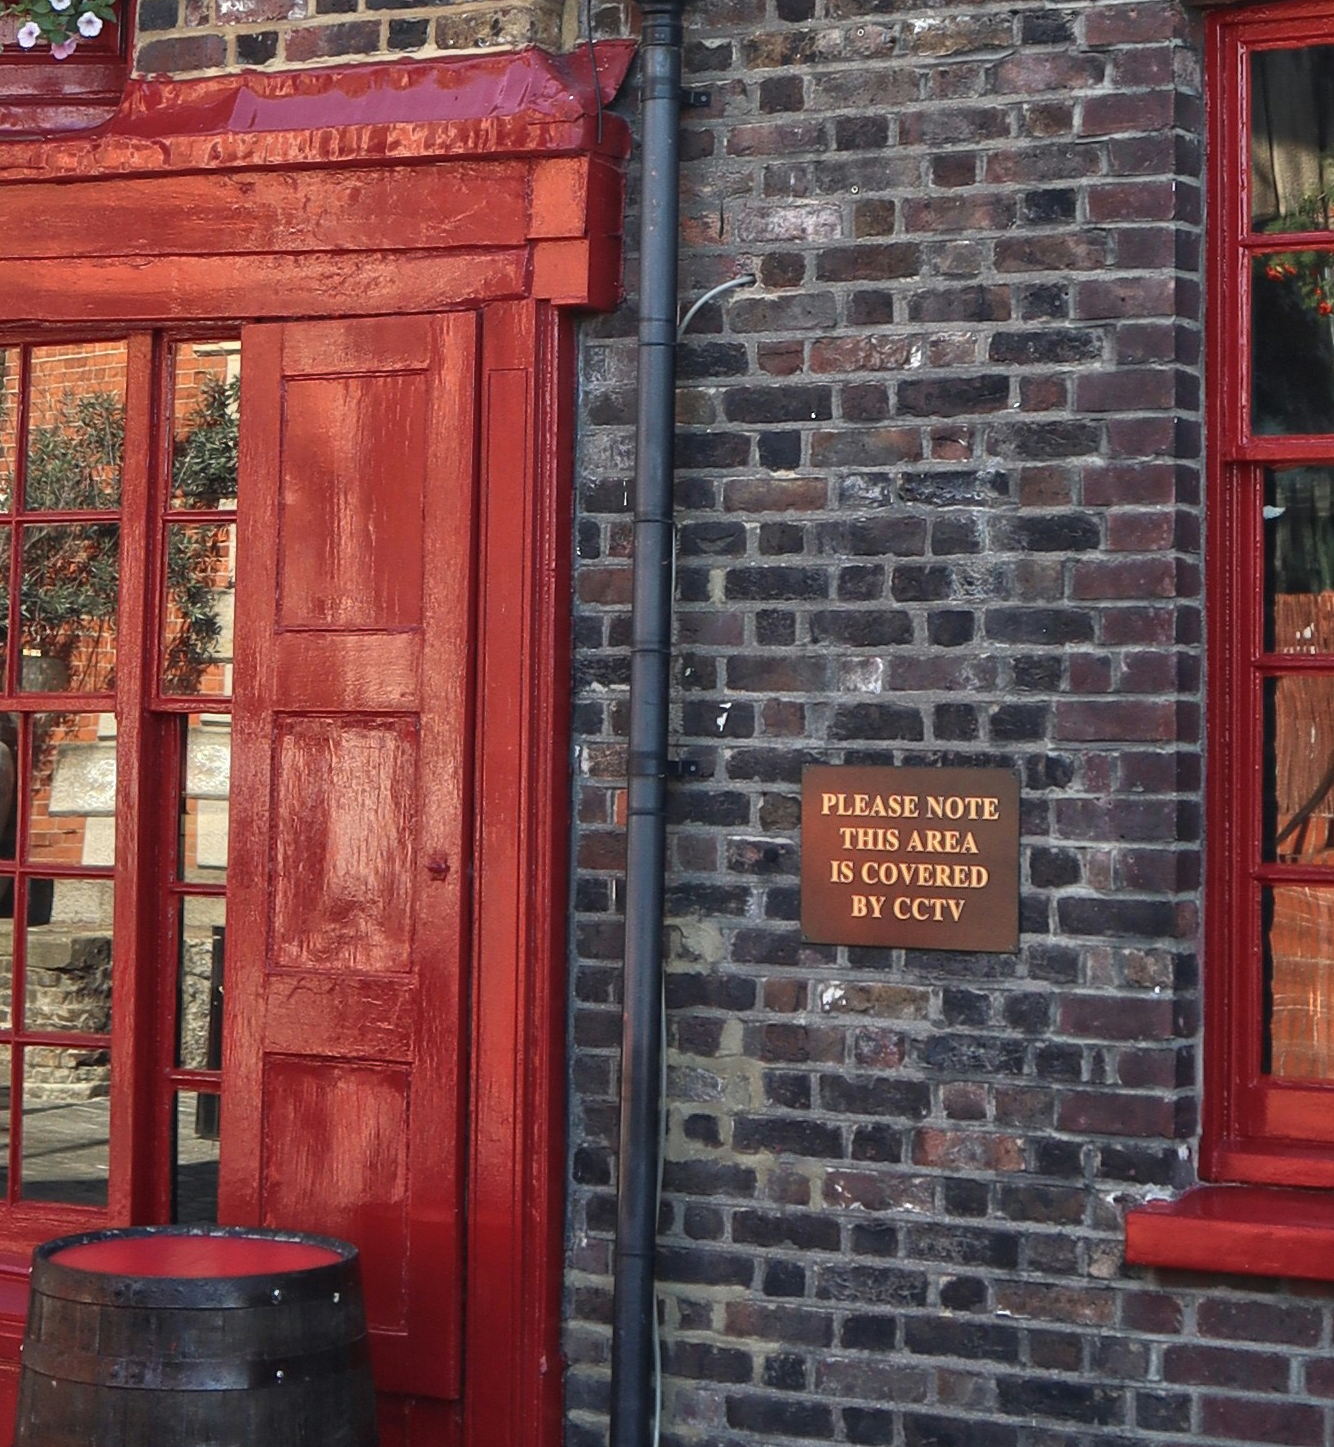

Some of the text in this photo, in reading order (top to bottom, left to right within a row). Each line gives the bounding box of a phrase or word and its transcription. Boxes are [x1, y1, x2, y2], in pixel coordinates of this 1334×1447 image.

[820, 793, 1000, 821] PLEASE NOTE
[839, 827, 980, 854] THIS AREA
[829, 860, 989, 889] IS COVERED
[851, 894, 966, 922] BY CCTV
